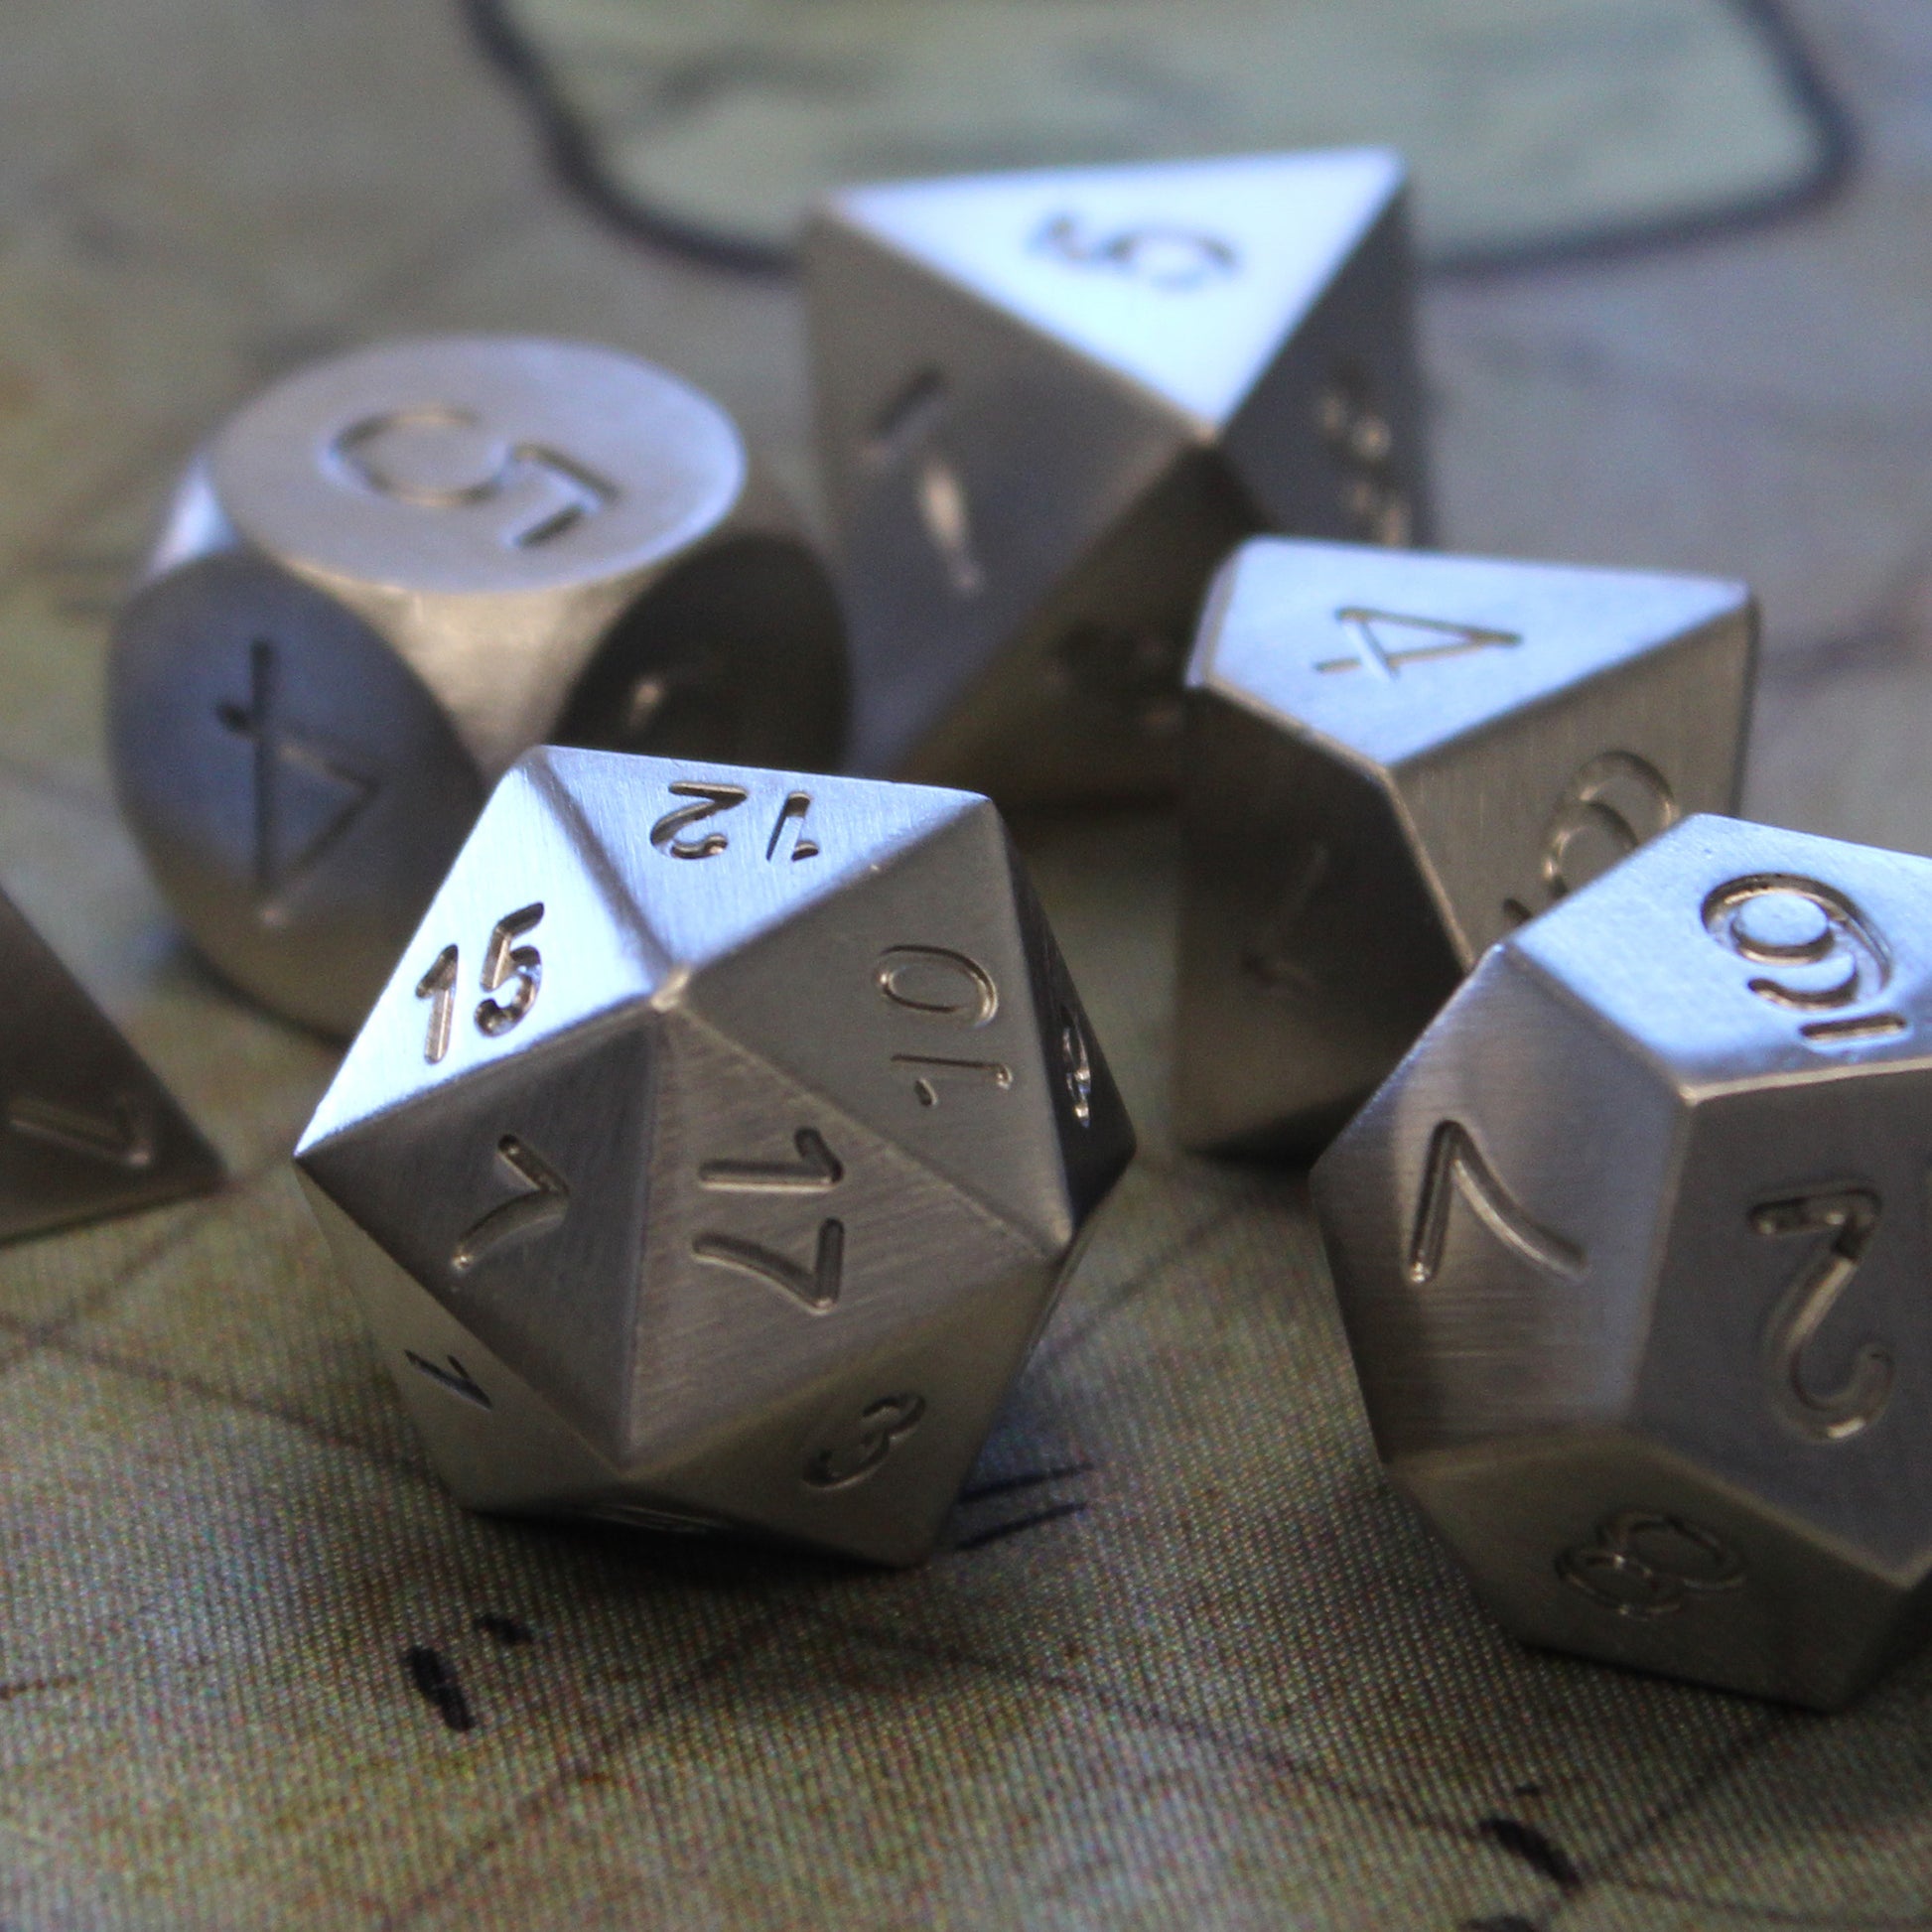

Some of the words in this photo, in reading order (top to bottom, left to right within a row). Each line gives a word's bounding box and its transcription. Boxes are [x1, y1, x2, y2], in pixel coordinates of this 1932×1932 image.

[318, 405, 621, 549] 5
[1313, 607, 1523, 680] 4
[213, 637, 381, 929] 4
[650, 780, 821, 863] 12
[415, 900, 545, 1065] 15
[876, 943, 1014, 1107] 10
[453, 1134, 571, 1273] 7
[693, 1126, 845, 1316] 17
[1403, 1119, 1588, 1285] 7
[1745, 1183, 1893, 1445] 2
[800, 1391, 928, 1487] 3
[1554, 1509, 1747, 1622] 8
